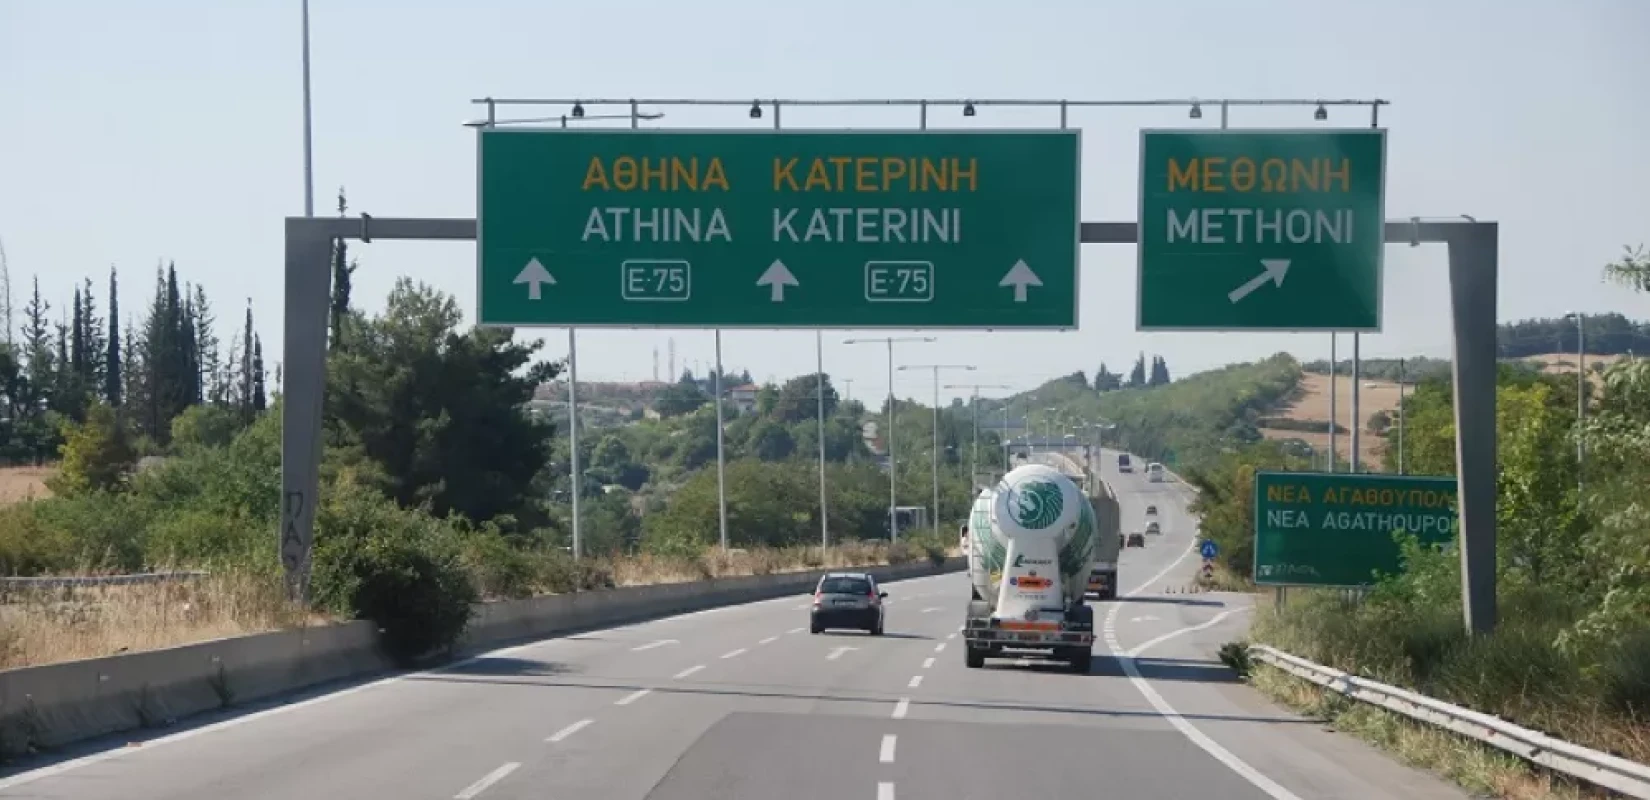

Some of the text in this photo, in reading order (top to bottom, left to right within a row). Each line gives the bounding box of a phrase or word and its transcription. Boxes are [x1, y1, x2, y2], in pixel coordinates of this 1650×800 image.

[583, 157, 976, 191] ΑΘΗΝΑ ΚΑΤΕΡΙΝΗ
[1167, 156, 1350, 192] ΜΕΘΩΝΗ
[583, 207, 960, 242] ATHINA KATERINI
[1167, 208, 1353, 244] METHONI
[1267, 484, 1455, 508] ΝΕΑ ΑΓΑΘΟΥΠΟΛ
[1267, 509, 1452, 535] NEA AGATHOUPO
